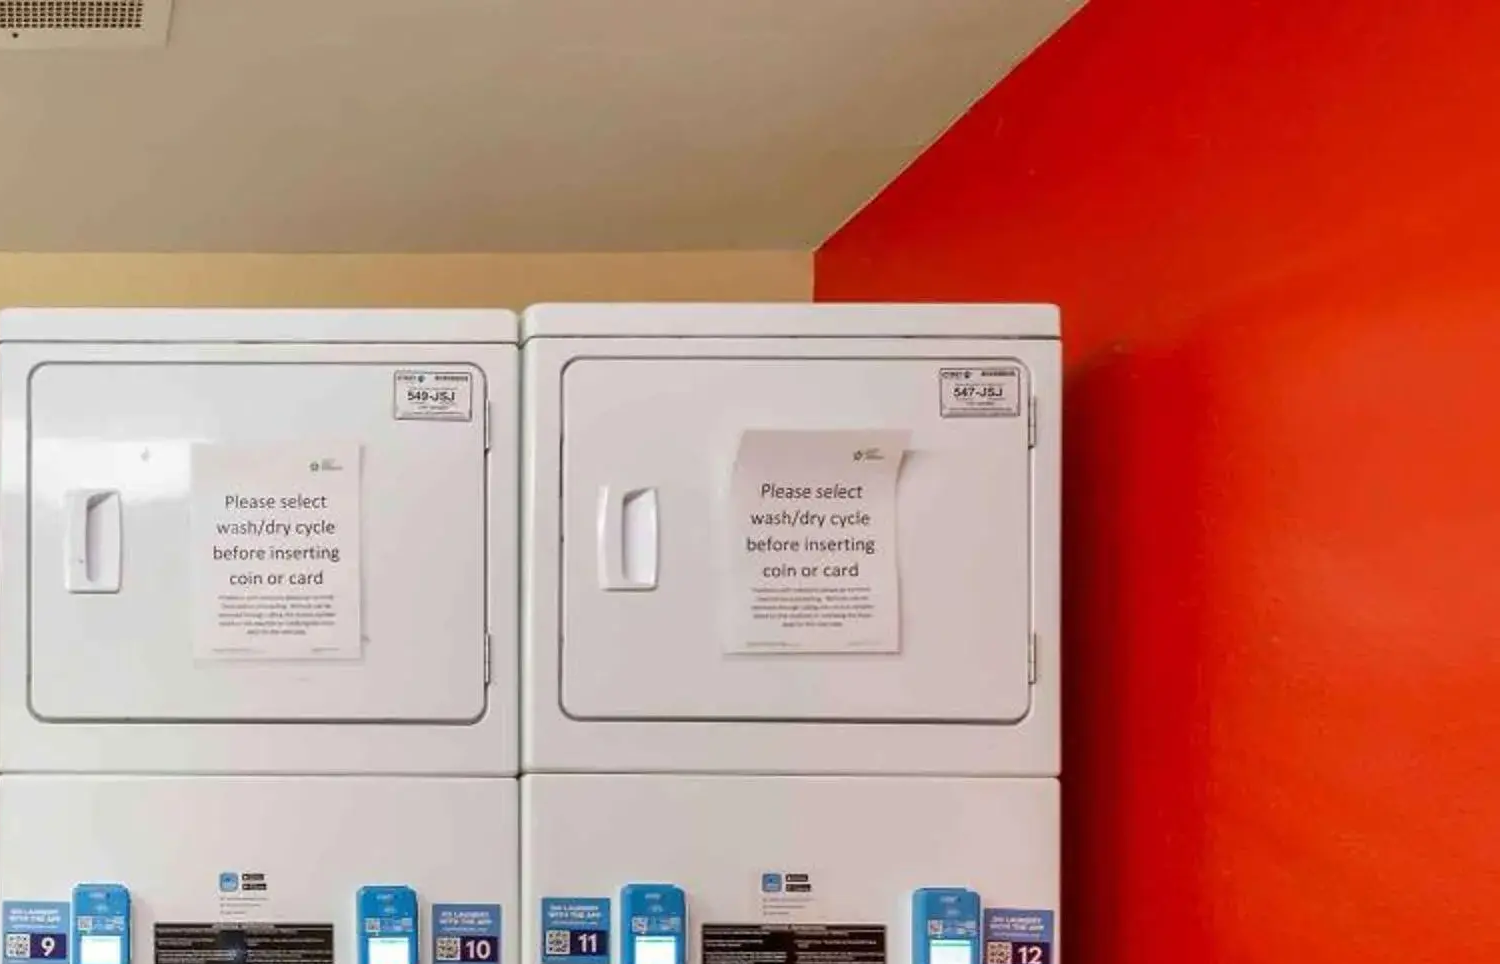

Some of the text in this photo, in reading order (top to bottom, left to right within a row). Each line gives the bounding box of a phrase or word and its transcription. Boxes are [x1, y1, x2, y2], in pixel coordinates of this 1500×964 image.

[953, 386, 1003, 397] 547-JSJ
[761, 483, 863, 499] Please select
[225, 494, 328, 509] Please select
[750, 510, 870, 527] wash/dry cycle
[217, 520, 336, 536] wash/dry cycle
[747, 537, 876, 554] before inserting
[213, 546, 340, 562] before inserting
[230, 570, 323, 585] coin or card
[763, 563, 859, 578] coin or card
[41, 937, 55, 956] 9
[466, 941, 491, 959] 10
[578, 933, 597, 952] 11
[1018, 946, 1042, 964] 12
